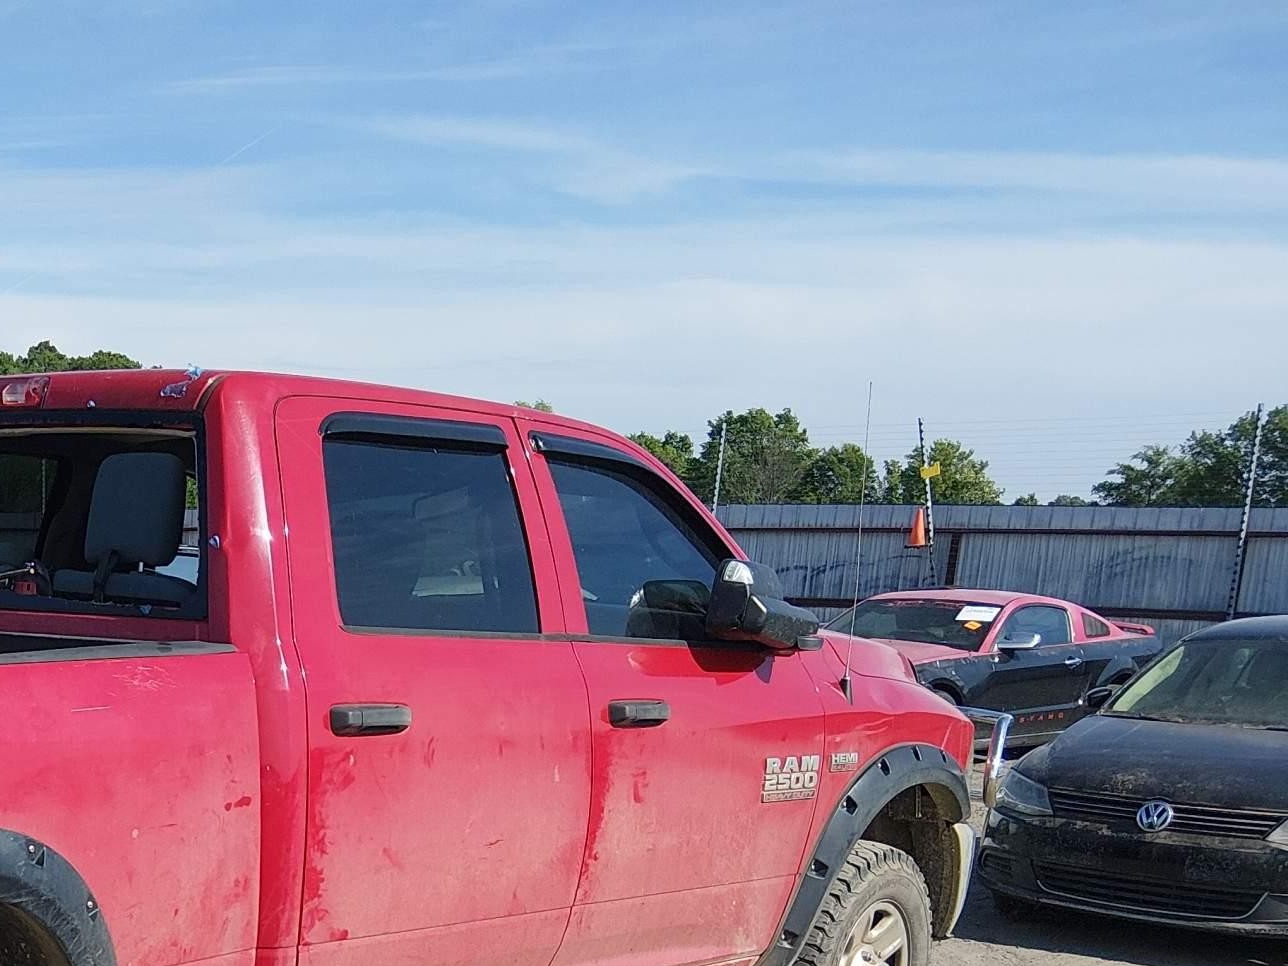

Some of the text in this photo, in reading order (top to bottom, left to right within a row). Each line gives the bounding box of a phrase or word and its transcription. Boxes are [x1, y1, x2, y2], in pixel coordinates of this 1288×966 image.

[766, 755, 820, 774] RAM
[831, 752, 858, 764] HEMI
[764, 772, 818, 791] 2500
